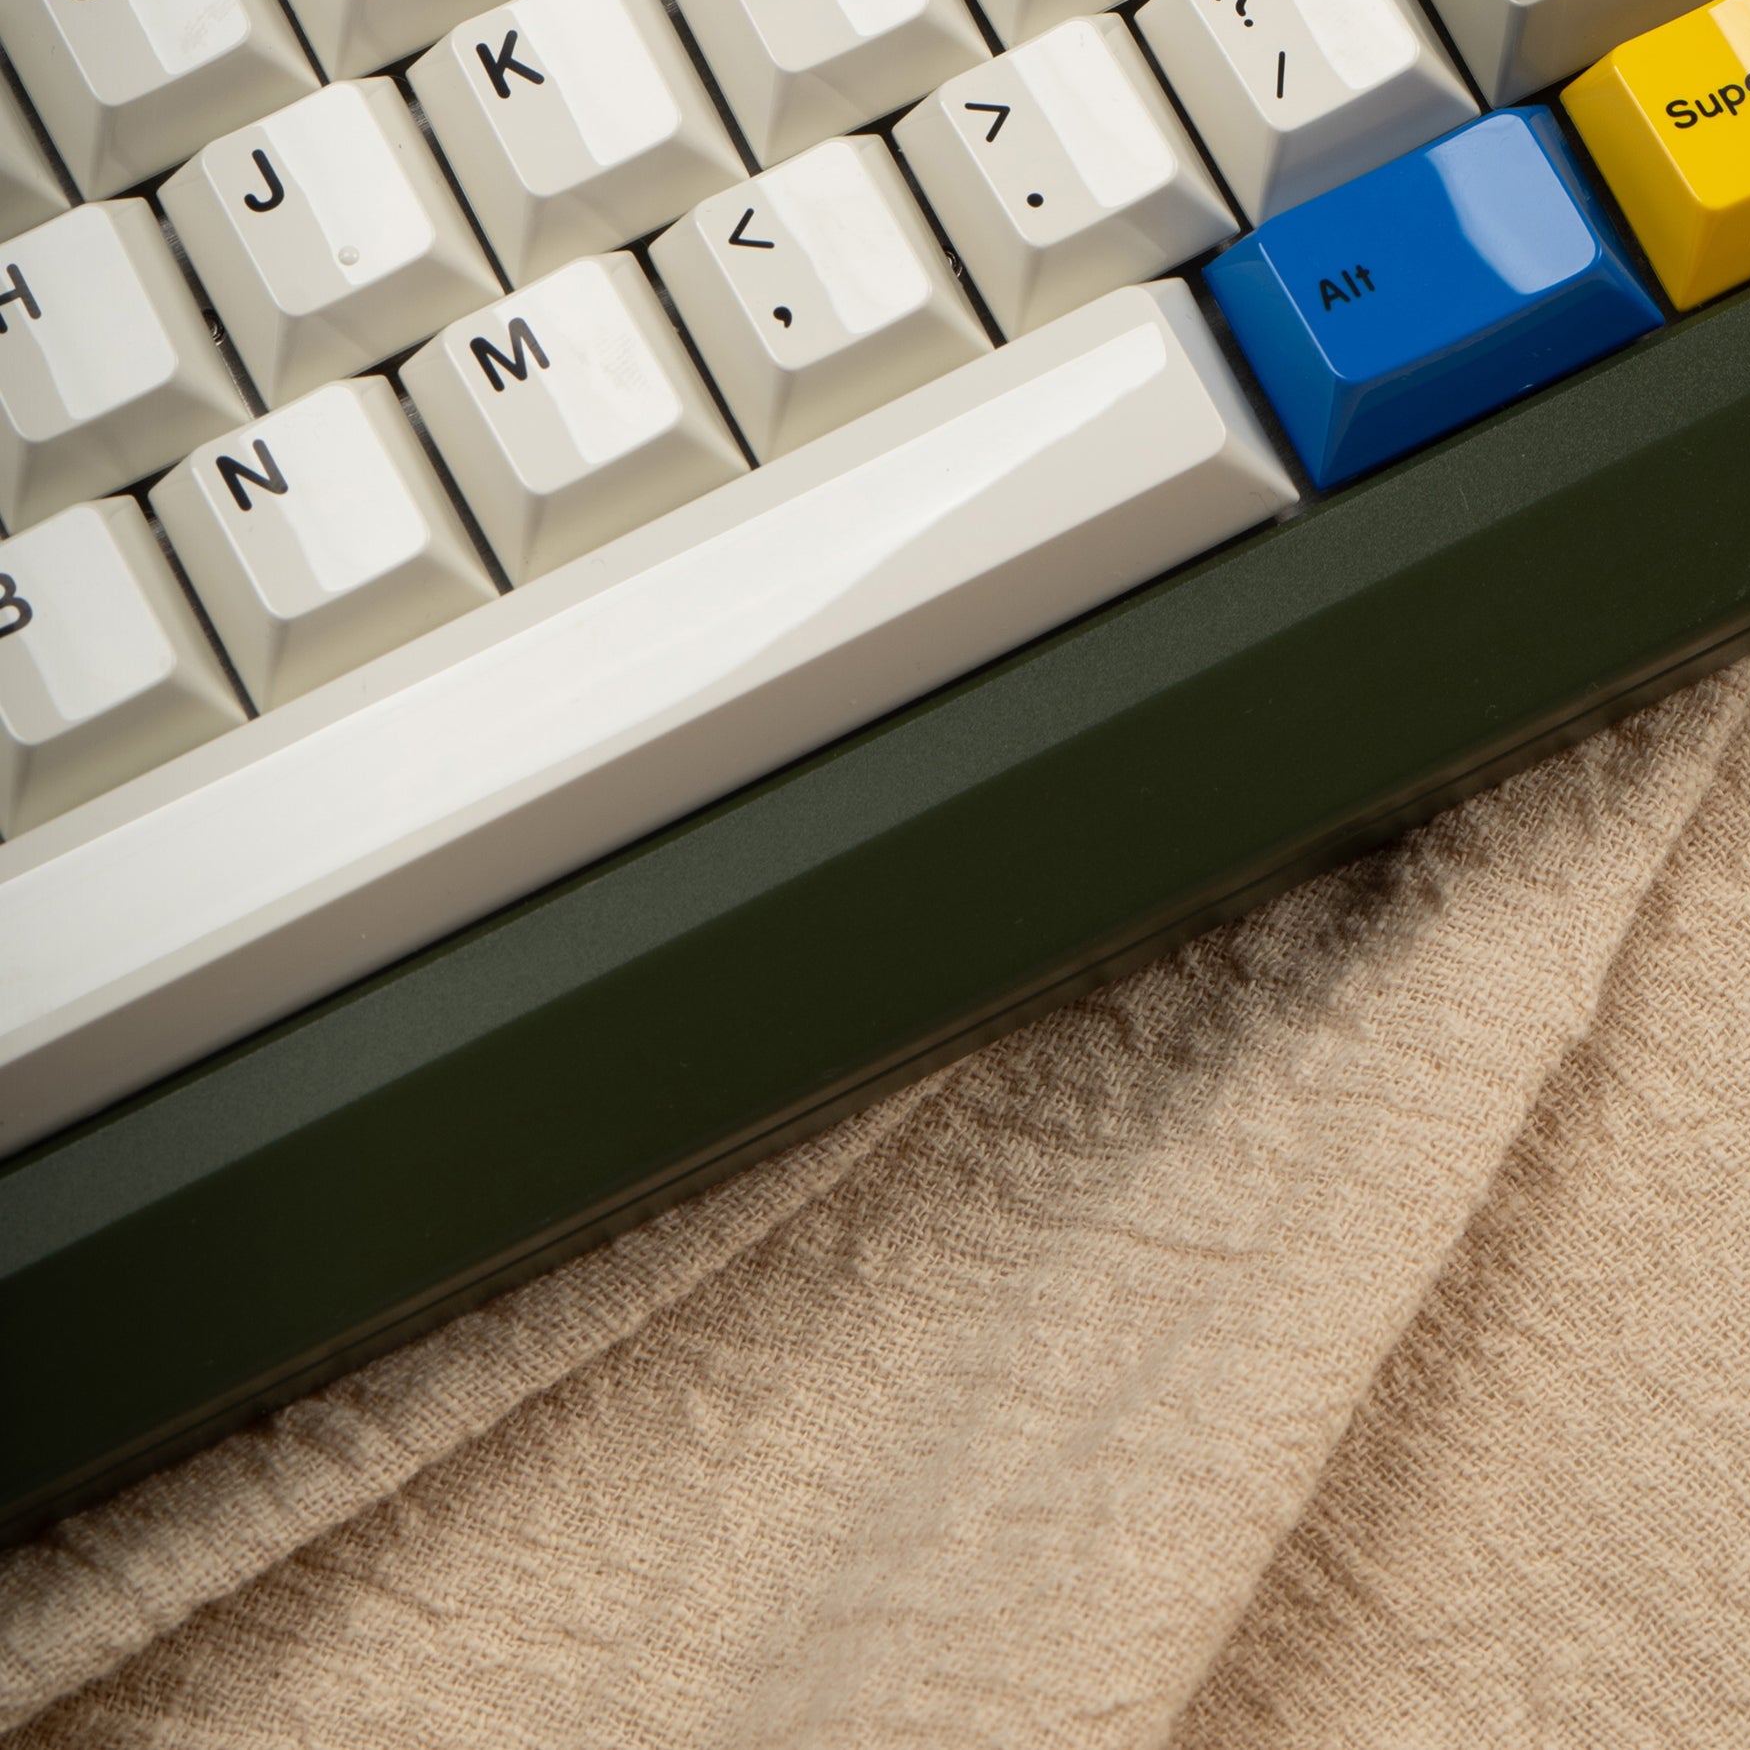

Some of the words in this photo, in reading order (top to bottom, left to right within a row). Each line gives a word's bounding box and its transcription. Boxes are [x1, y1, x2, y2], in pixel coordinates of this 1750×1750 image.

[475, 29, 545, 99] K
[964, 102, 1011, 143] >
[243, 149, 285, 213] J
[728, 208, 775, 249] <
[1318, 264, 1375, 312] Alt
[772, 306, 793, 329] ,
[469, 317, 550, 393] M
[215, 439, 289, 512] N
